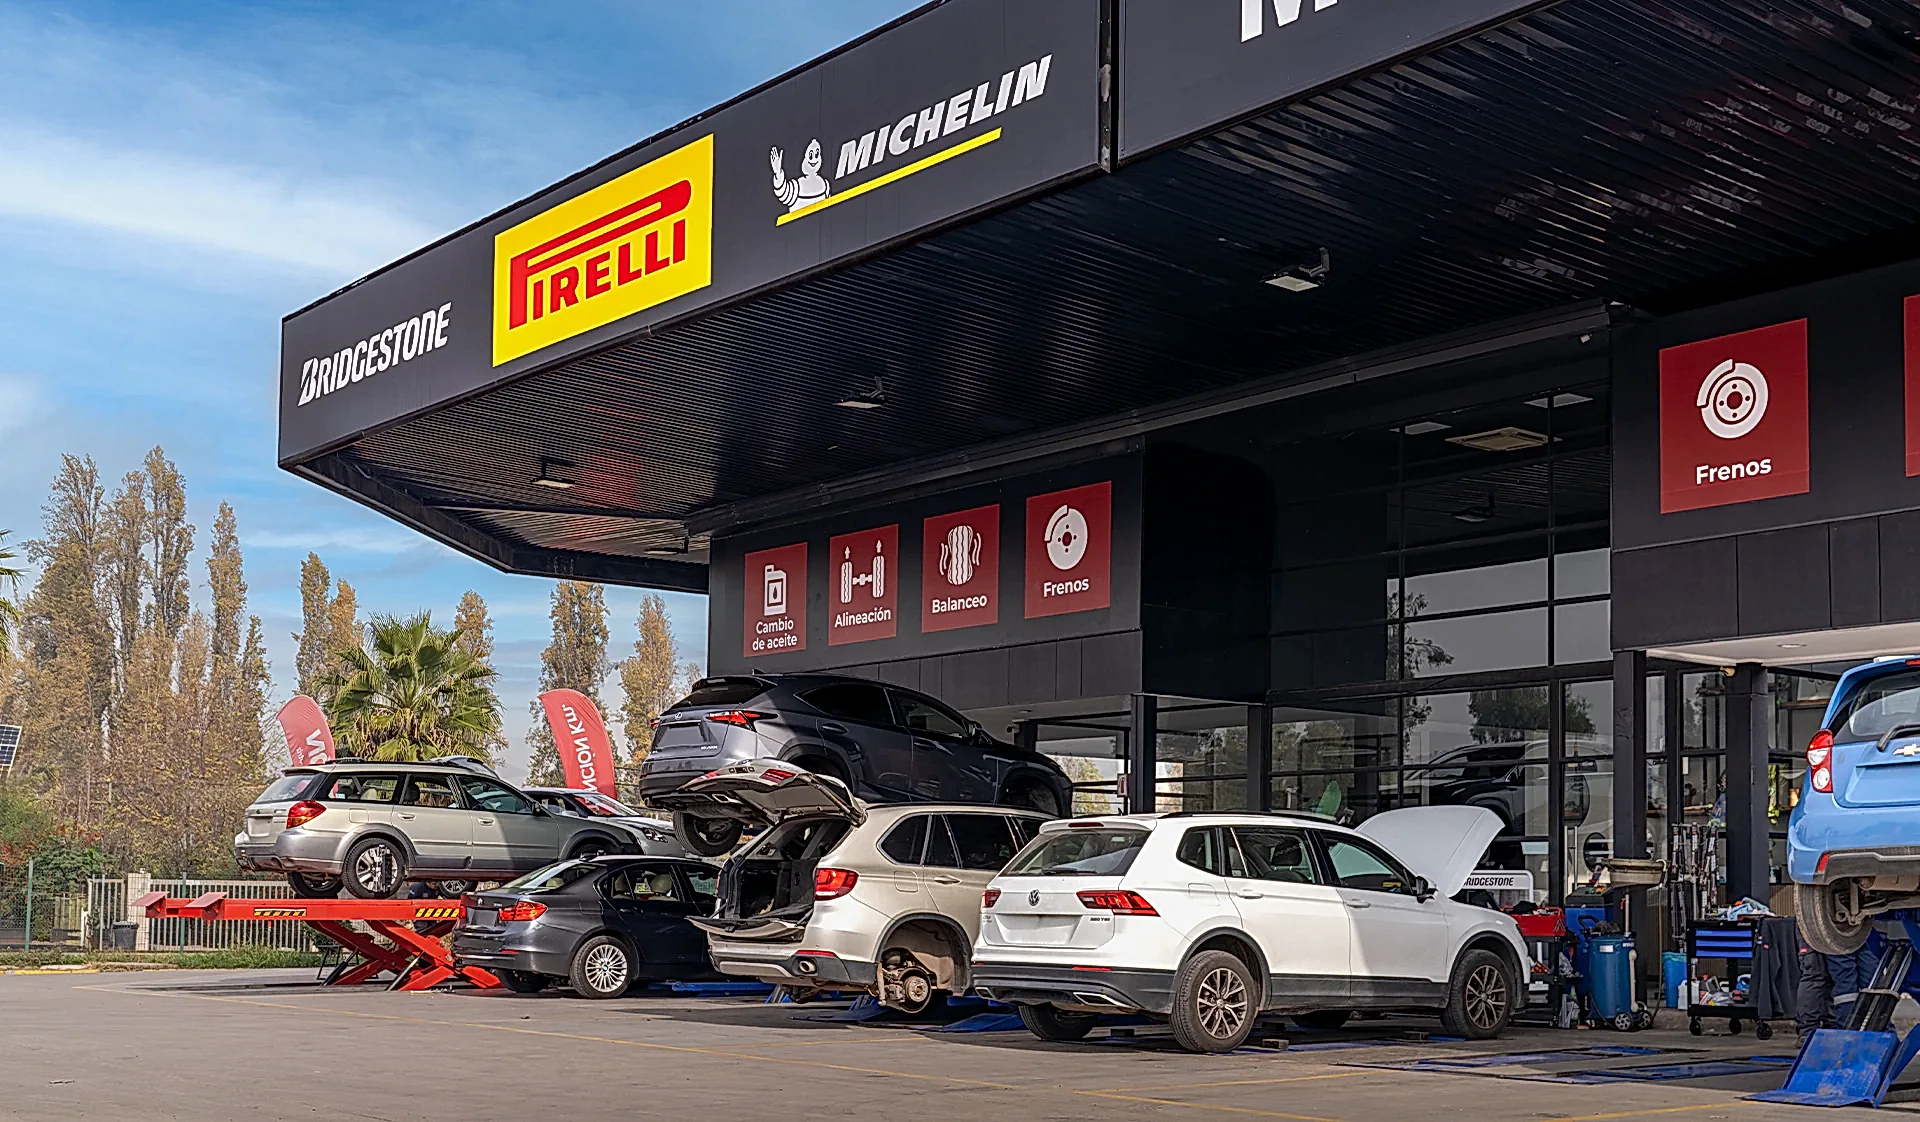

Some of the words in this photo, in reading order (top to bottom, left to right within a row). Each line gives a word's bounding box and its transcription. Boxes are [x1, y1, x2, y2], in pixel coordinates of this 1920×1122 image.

[835, 54, 1052, 180] MICHELIN
[509, 179, 692, 330] PIRELLI
[298, 302, 452, 407] BRIDGESTONE
[1696, 458, 1772, 485] Frenos
[1043, 578, 1090, 598] Frenos
[931, 595, 988, 614] Balanceo
[755, 617, 794, 634] Cambio
[834, 606, 892, 628] Alineación
[752, 637, 765, 651] de
[766, 634, 798, 648] aceite
